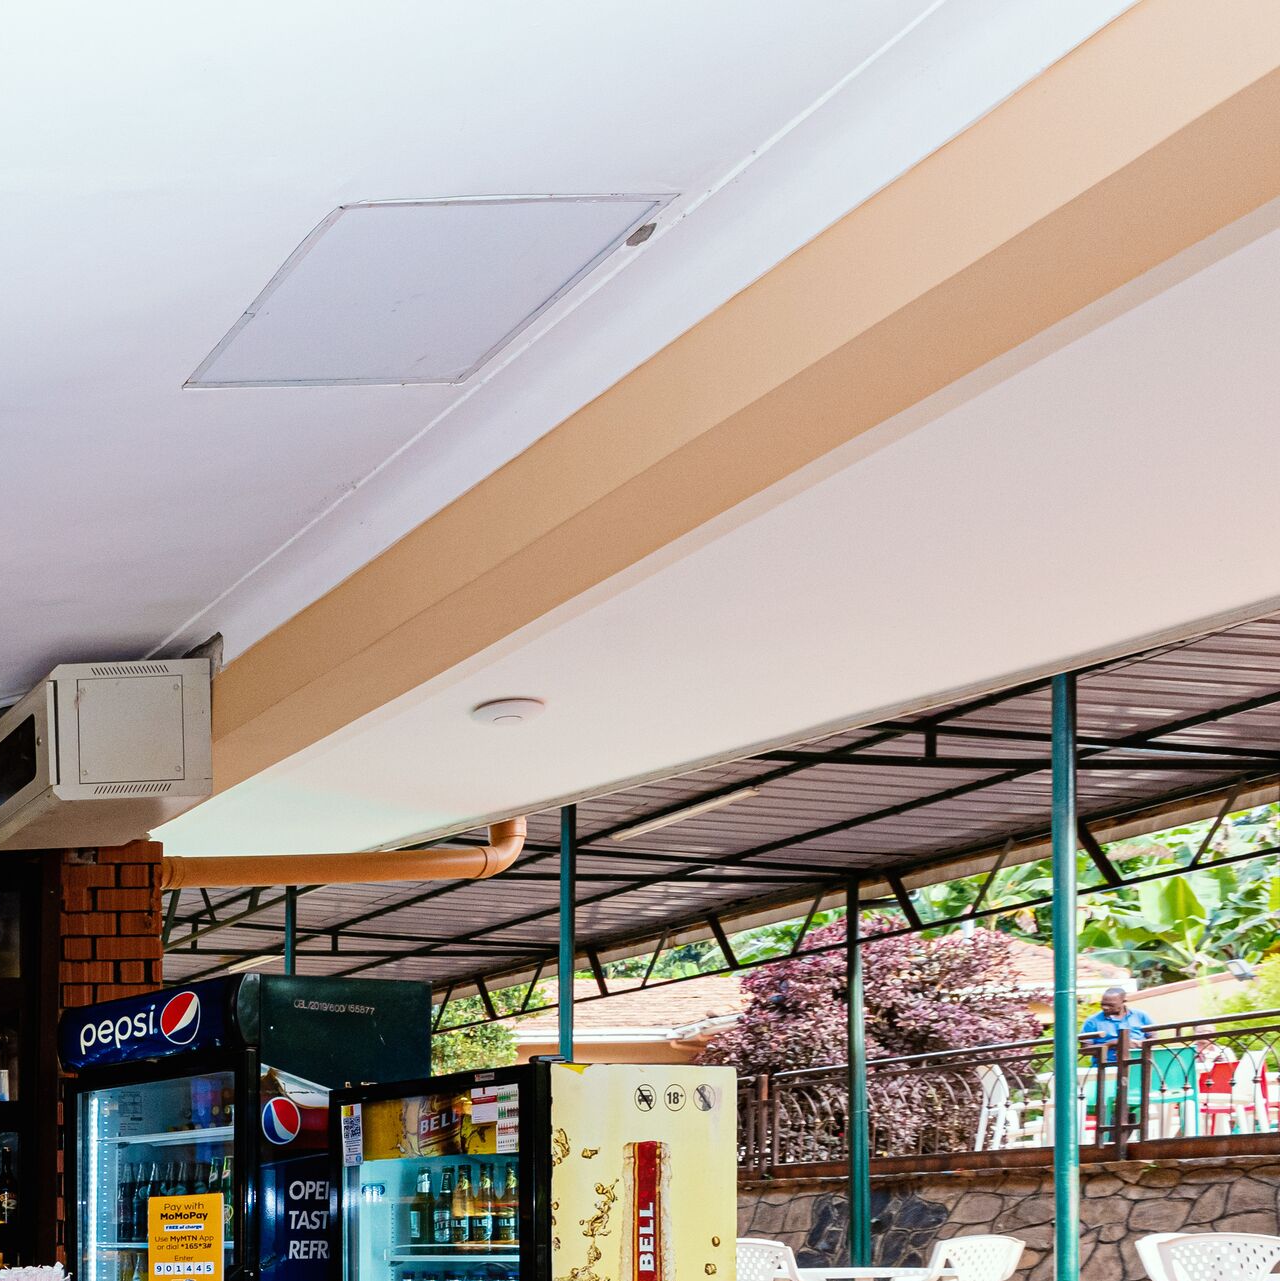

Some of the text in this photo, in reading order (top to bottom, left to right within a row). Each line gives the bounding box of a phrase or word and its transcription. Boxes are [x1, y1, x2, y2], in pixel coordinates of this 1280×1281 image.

[80, 1004, 155, 1055] pepsi
[667, 1091, 684, 1105] 18+
[420, 1110, 460, 1134] BELL
[160, 1212, 208, 1221] MoMoPay
[164, 1202, 204, 1212] Pay with
[289, 1210, 329, 1230] TAST
[170, 1235, 197, 1243] MyMTN
[639, 1202, 654, 1272] BELL
[289, 1240, 330, 1260] REFR
